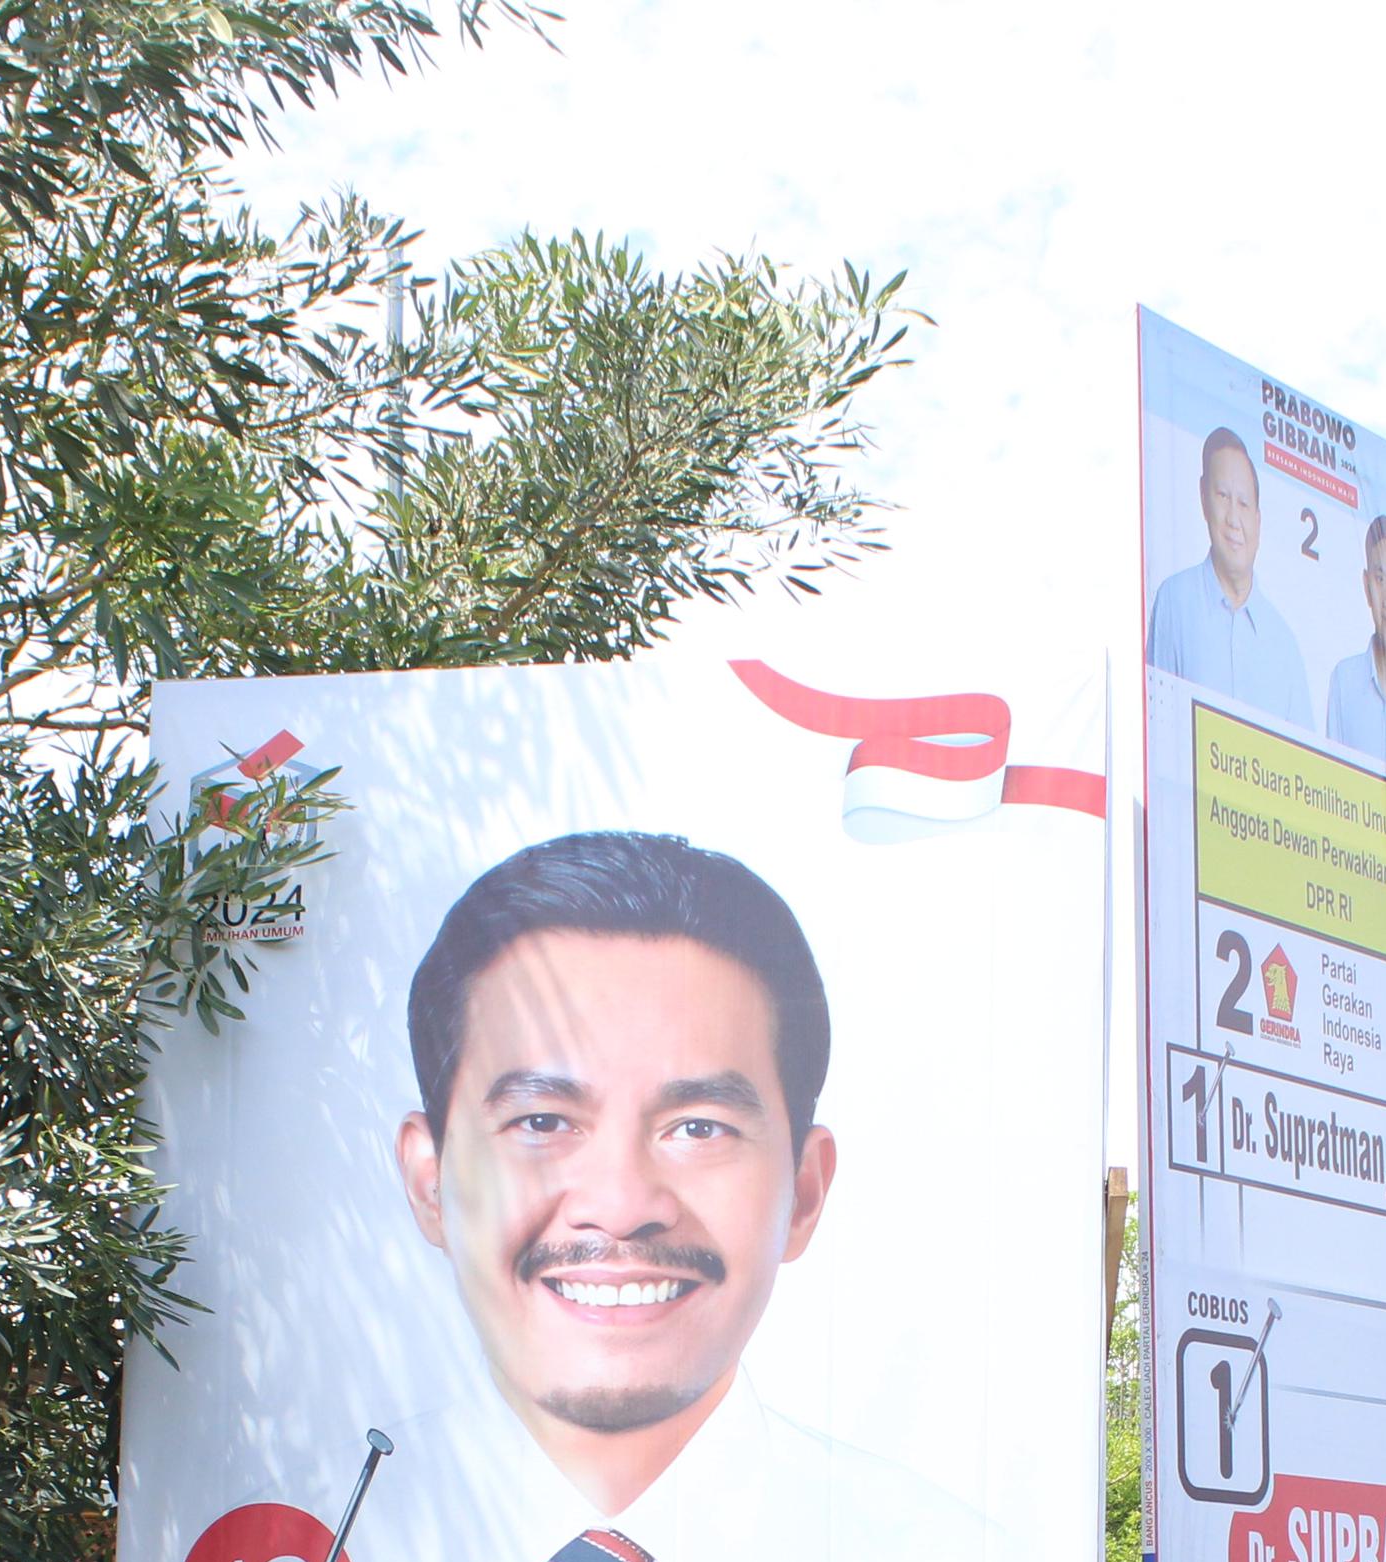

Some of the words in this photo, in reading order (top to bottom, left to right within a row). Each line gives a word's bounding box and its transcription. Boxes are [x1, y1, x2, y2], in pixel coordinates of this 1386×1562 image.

[1262, 379, 1357, 451] PRABOWO
[1262, 411, 1336, 470] GIBRAN
[1300, 507, 1319, 561] 2
[1209, 741, 1248, 782] Surat
[1251, 757, 1290, 797] Suara
[1294, 774, 1358, 824] Pemilihan
[1209, 796, 1269, 843] Anggota
[1273, 818, 1318, 860] Dewan
[1306, 881, 1336, 917] DPR
[1339, 893, 1352, 922] RI
[1216, 929, 1253, 1036] 2
[1321, 953, 1357, 985] Partai
[1322, 983, 1373, 1020] Gerakan
[1323, 1012, 1382, 1051] Indonesia
[1323, 1042, 1354, 1074] Raya
[1182, 1064, 1207, 1164] 1
[1231, 1096, 1257, 1155] Dr.
[1187, 1291, 1250, 1325] COBLOS
[1210, 1360, 1233, 1479] 1
